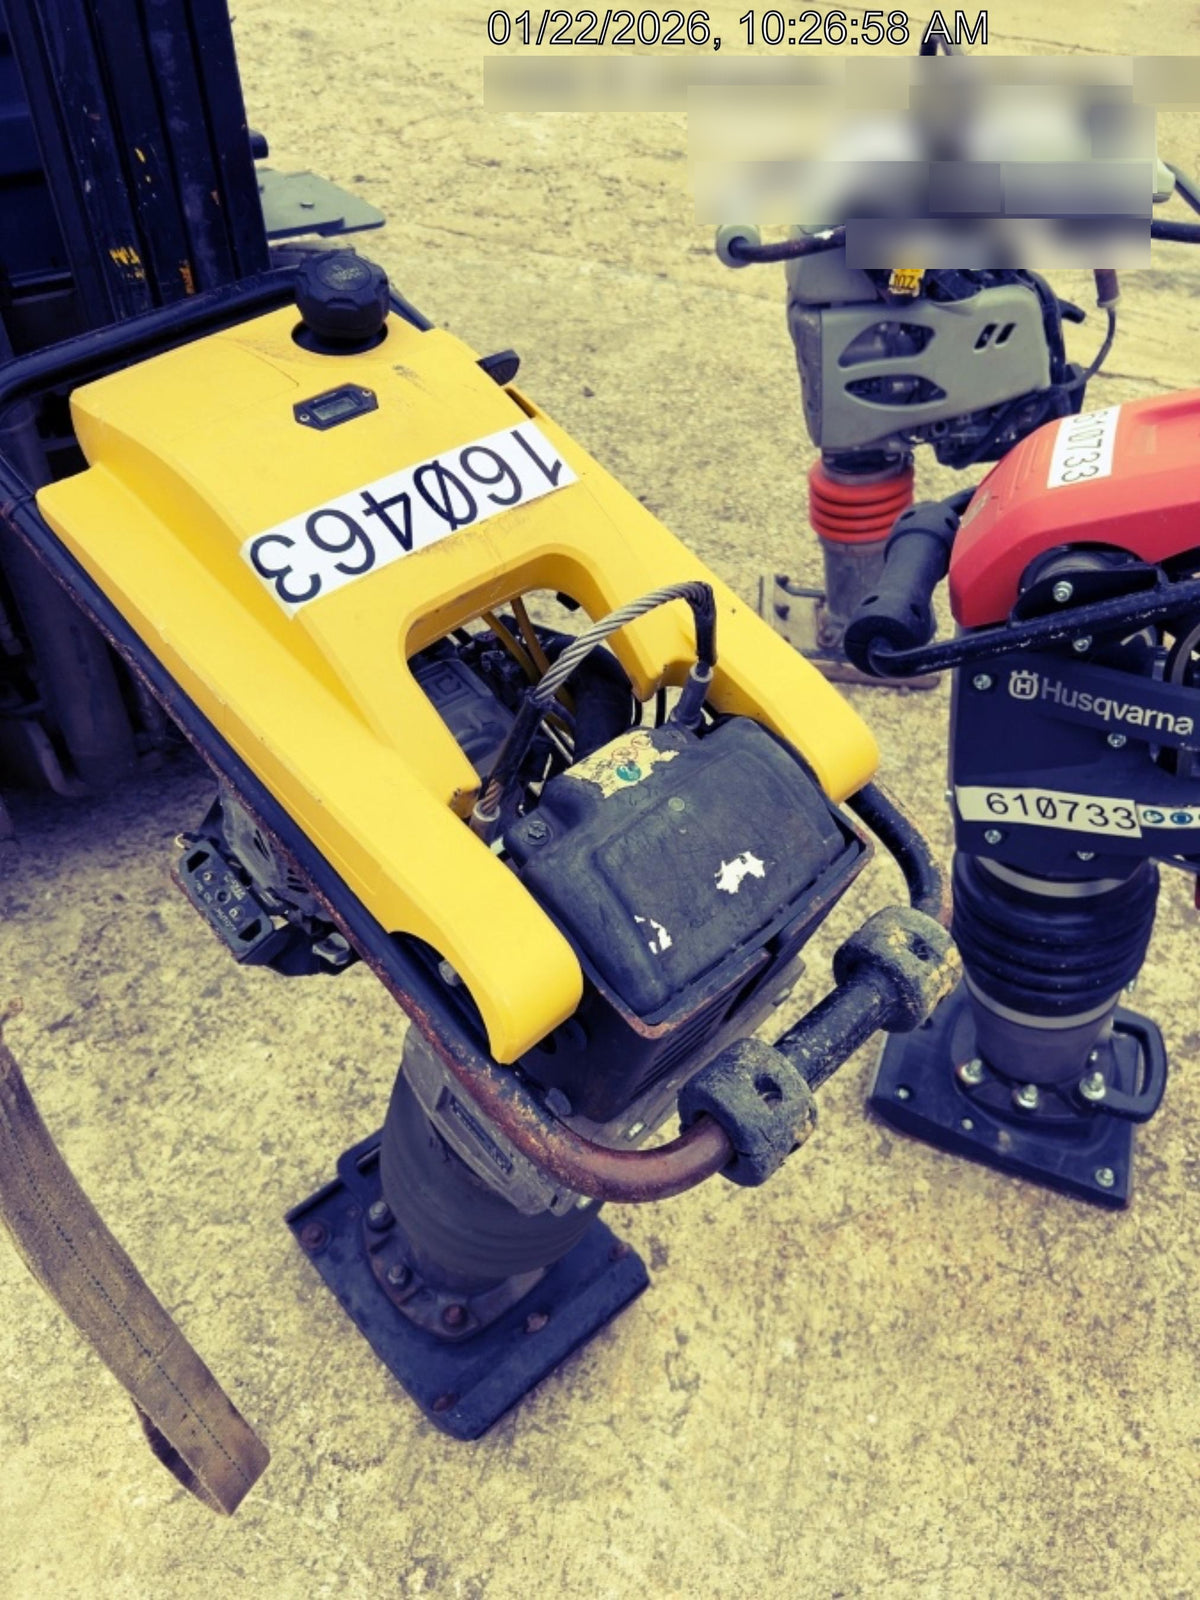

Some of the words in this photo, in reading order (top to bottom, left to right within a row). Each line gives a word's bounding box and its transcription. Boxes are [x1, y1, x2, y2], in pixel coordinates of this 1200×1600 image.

[250, 430, 562, 604] 160463
[1041, 677, 1193, 735] Husqvarna
[986, 791, 1138, 832] 610733
